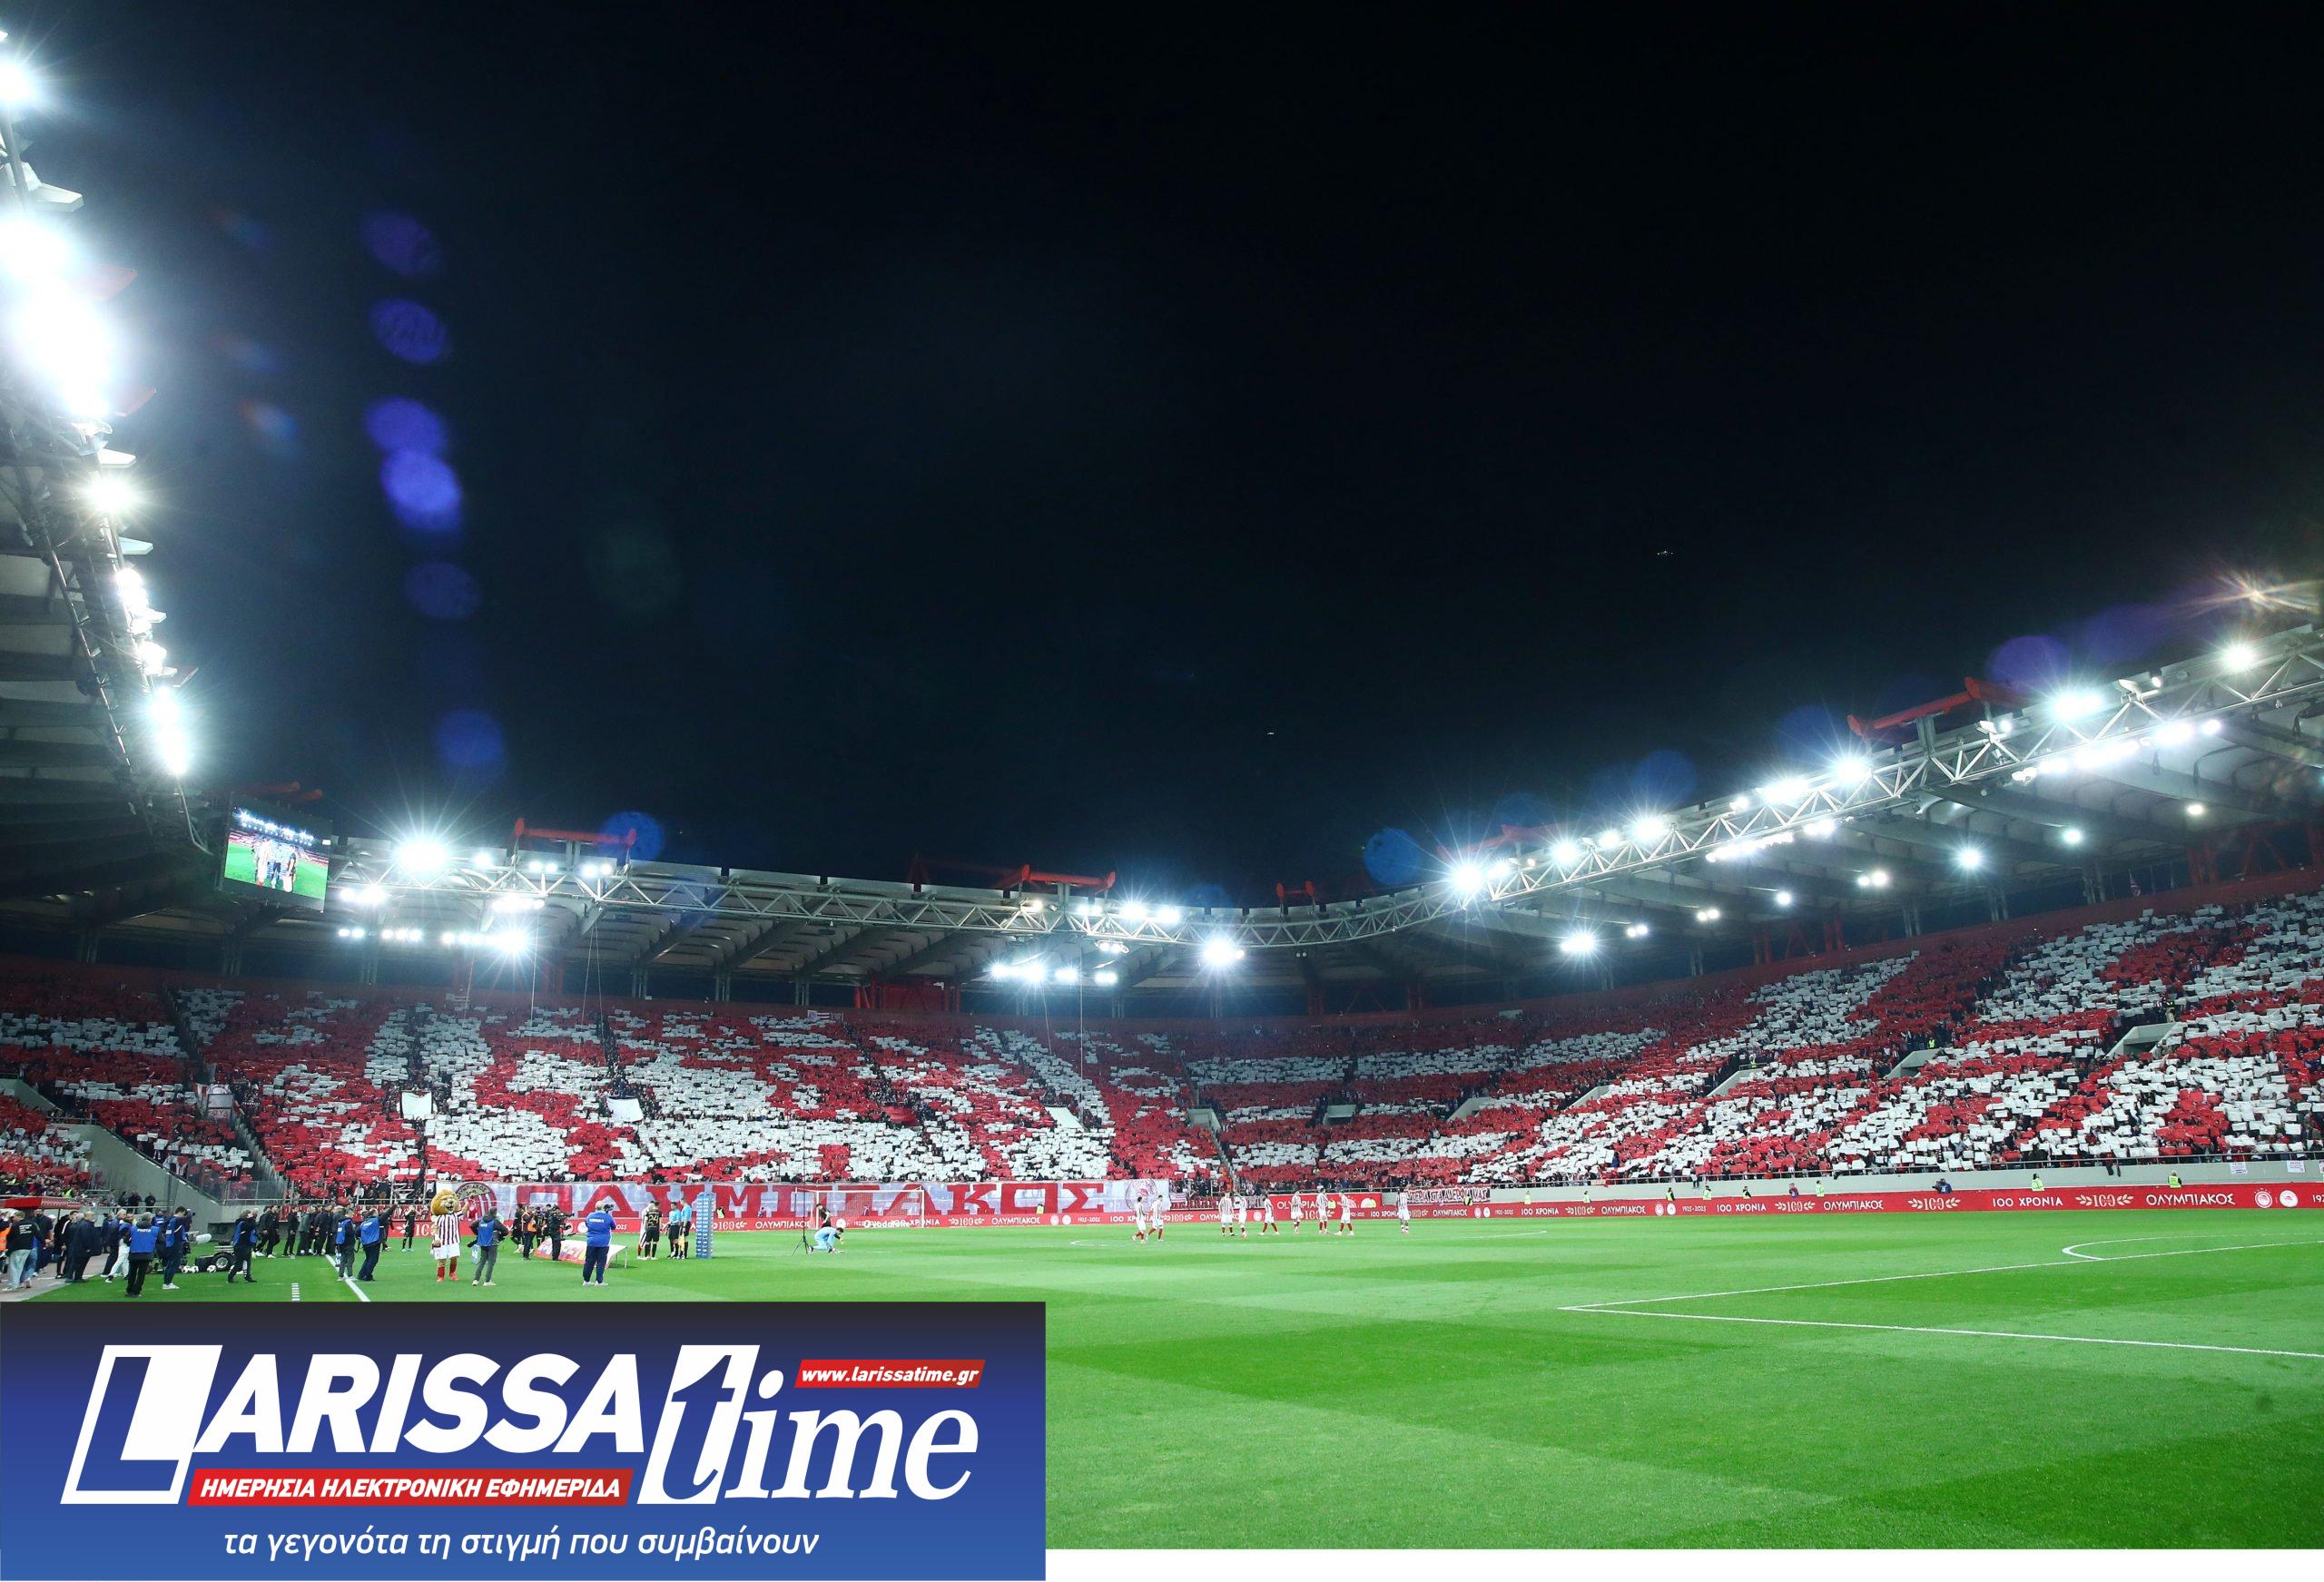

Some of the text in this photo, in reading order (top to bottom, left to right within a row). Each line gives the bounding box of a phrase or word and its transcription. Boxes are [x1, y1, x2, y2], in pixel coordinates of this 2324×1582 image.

[1535, 1207, 1560, 1215] ΧΡΟΝΙΑ
[1600, 1205, 1647, 1214] ΟΛΥΜΠΙΑΚΟΣ
[1717, 1204, 1732, 1213] 100
[1735, 1203, 1767, 1213] ΧΡΟΝΙΑ
[1823, 1199, 1885, 1211] ΟΛΥΜΠΙΑΚΟΣ
[1992, 1197, 2014, 1207] 100
[2018, 1196, 2063, 1207] ΧΡΟΝΙΑ
[2145, 1192, 2237, 1206] ΟΛΥΜΠΙΑΚΟΣ
[647, 1214, 660, 1224] 24
[991, 1216, 1041, 1225] ΟΛΥΜΠΙΑΚΟΣ
[755, 1220, 812, 1229] ΟΛΥΜΠΙΑΚΟΣ
